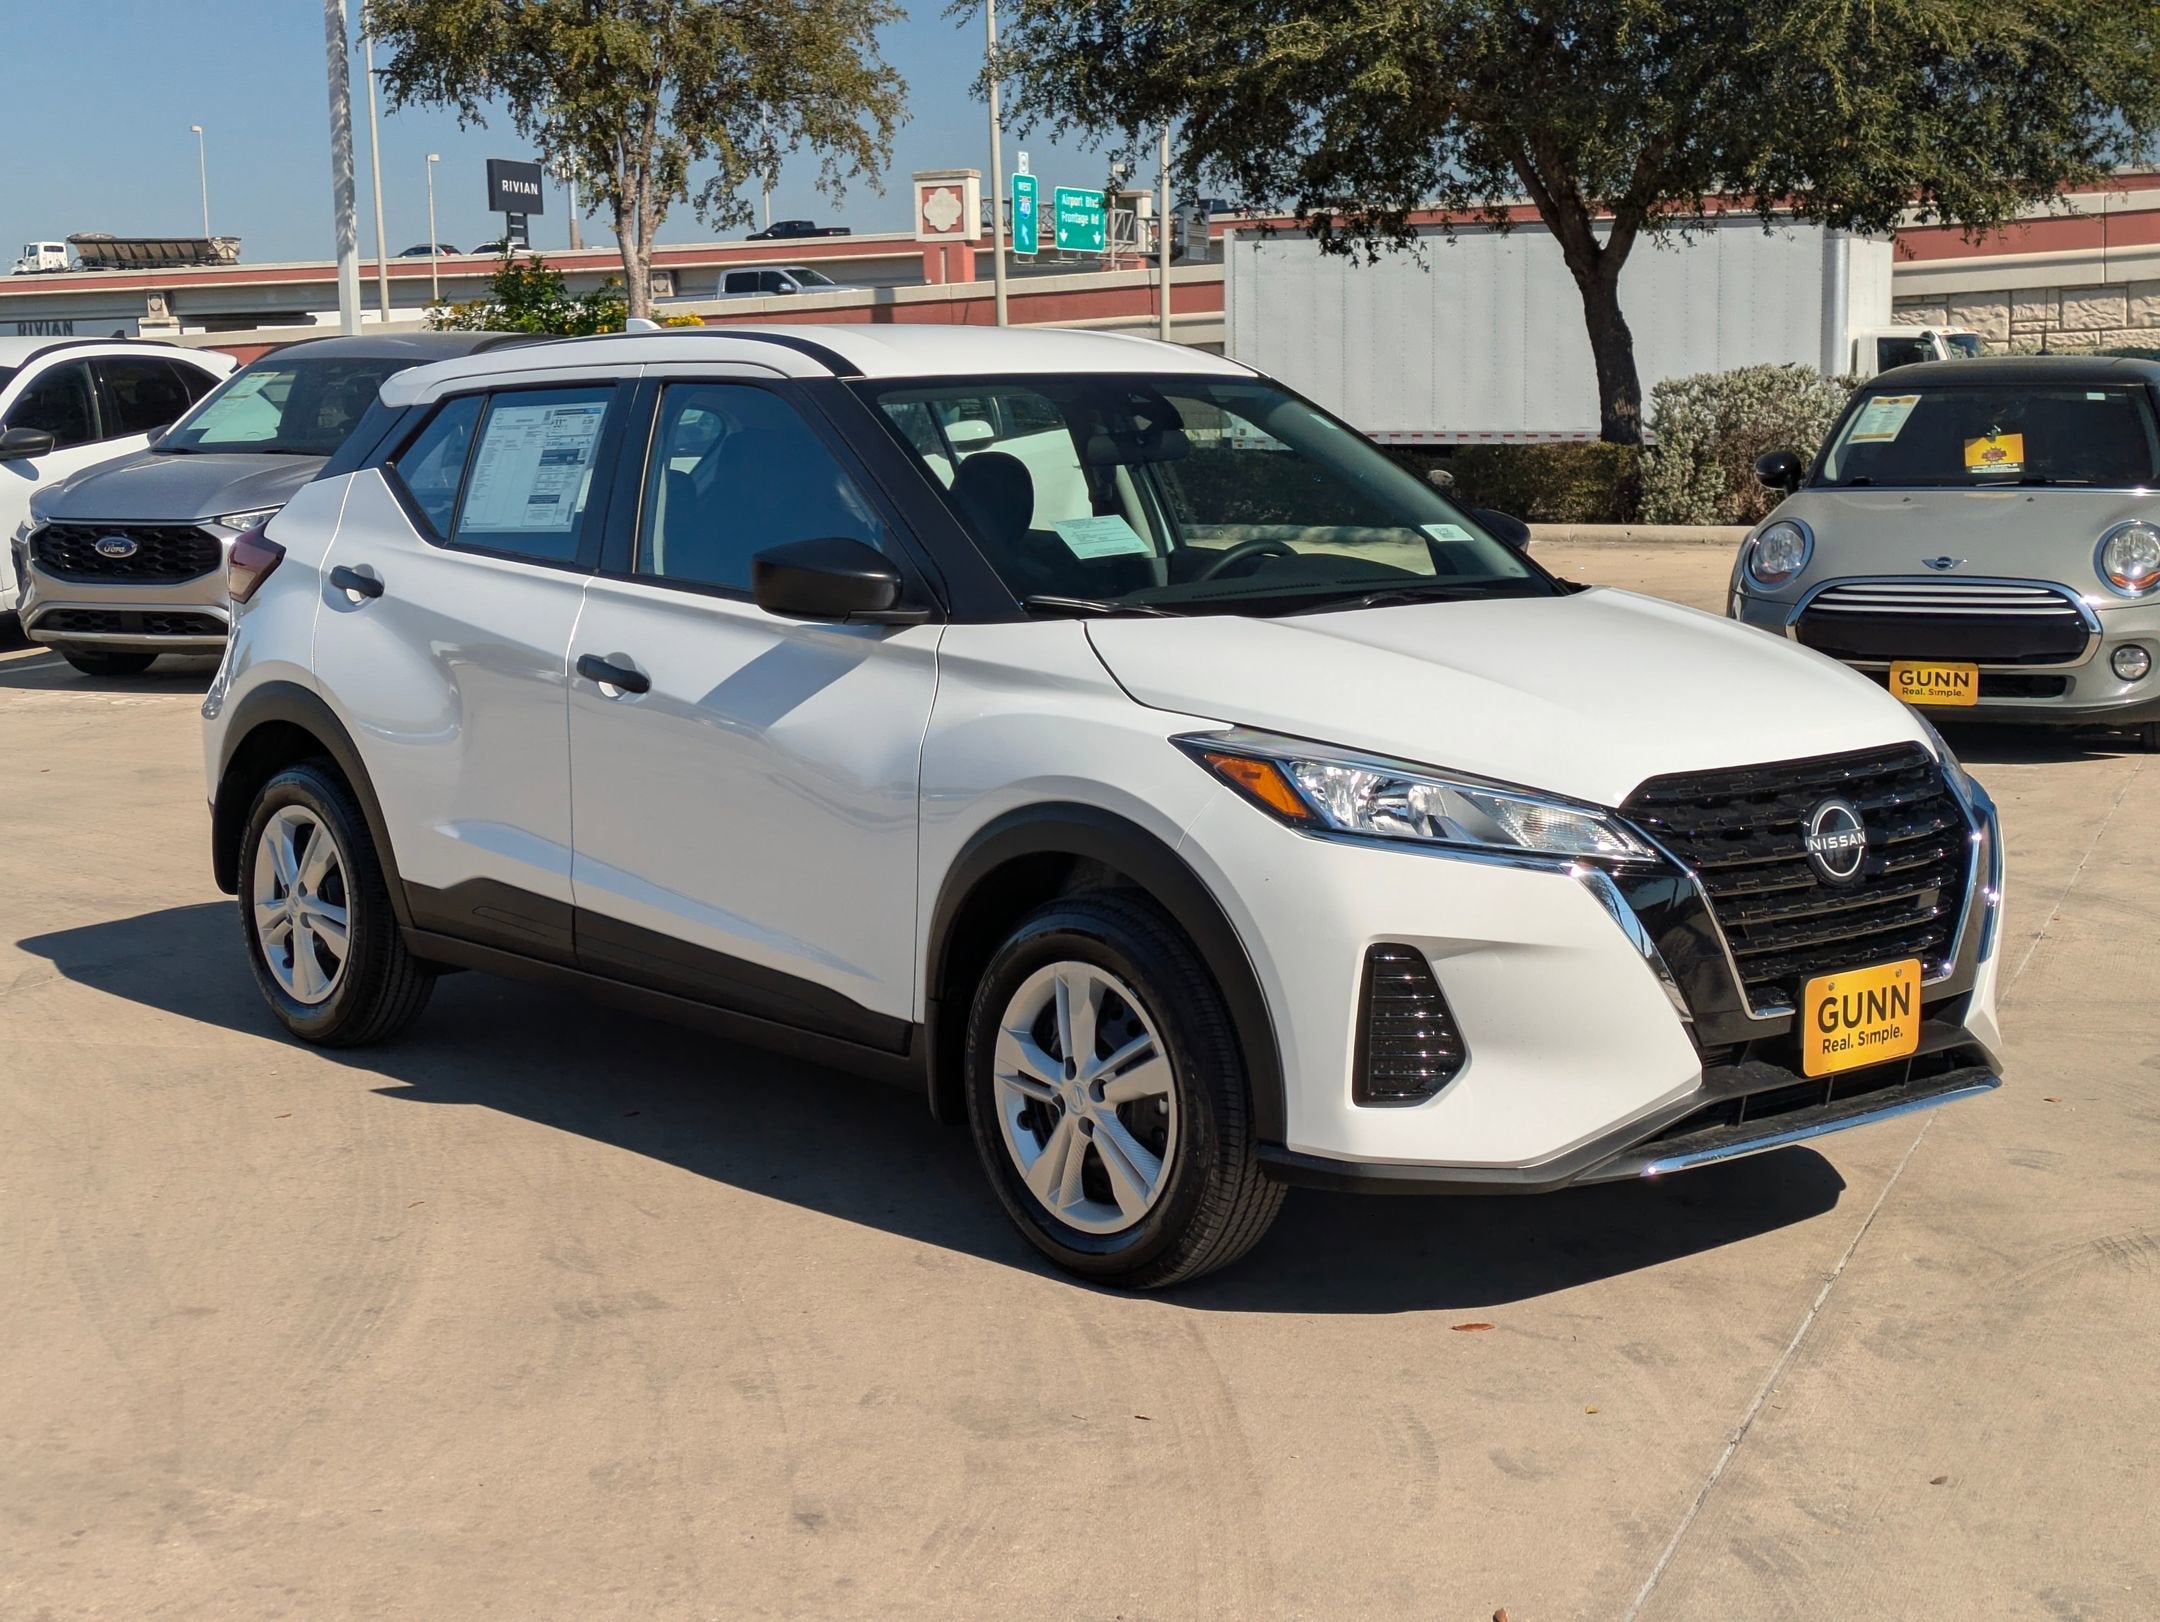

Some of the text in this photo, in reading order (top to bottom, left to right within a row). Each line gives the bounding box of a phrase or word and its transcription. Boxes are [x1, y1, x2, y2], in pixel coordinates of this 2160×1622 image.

[501, 179, 539, 195] RIVIAN
[1061, 193, 1099, 208] Airport Blvd
[1061, 211, 1099, 227] Frontage Rd
[17, 320, 74, 337] RIVIAN
[103, 541, 126, 553] Ford
[1899, 670, 1970, 688] GUNN
[1902, 687, 1925, 696] Real.
[1809, 831, 1866, 851] NISSAN
[1818, 982, 1911, 1034] GUNN
[1822, 1034, 1854, 1055] Real.
